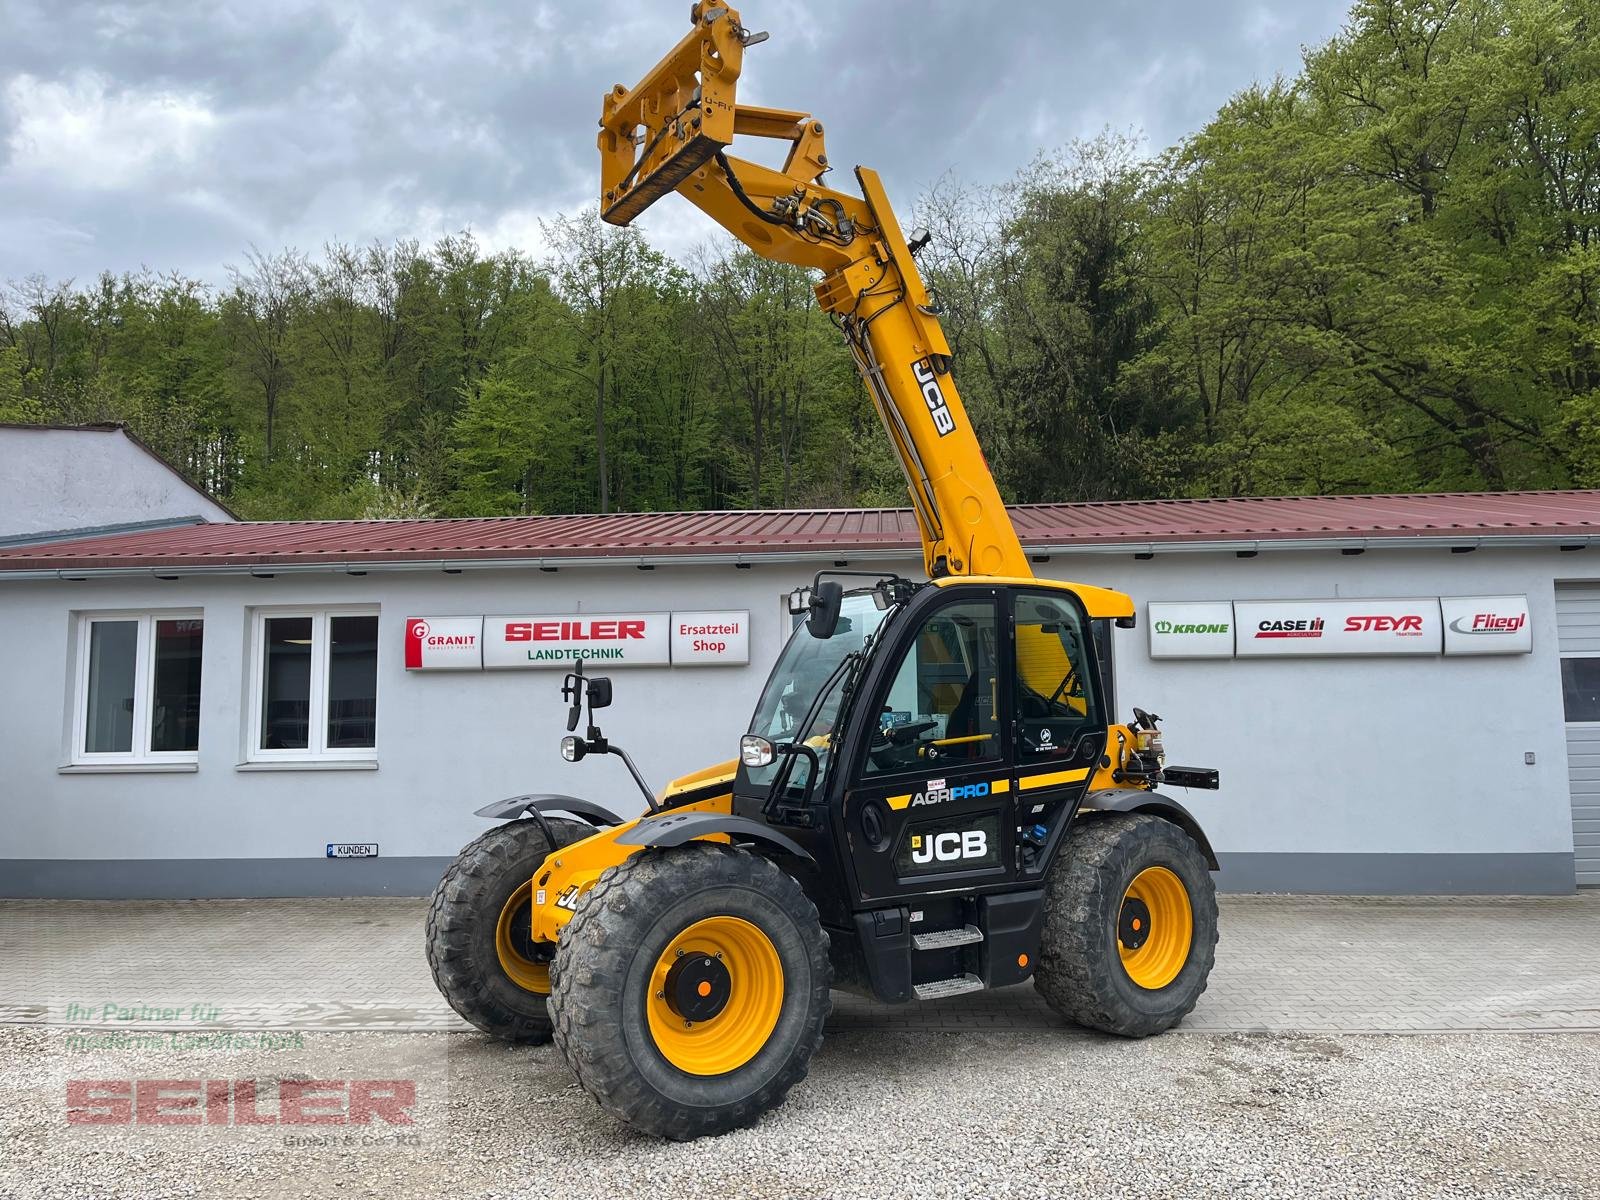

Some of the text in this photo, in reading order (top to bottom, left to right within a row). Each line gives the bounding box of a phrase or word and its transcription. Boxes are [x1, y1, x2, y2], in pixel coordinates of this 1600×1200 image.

[913, 362, 954, 435] JCB
[680, 622, 739, 636] Ersatzteil
[1172, 623, 1229, 634] KRONE
[1258, 620, 1307, 631] CASE
[1344, 616, 1423, 631] STEYR
[1472, 613, 1525, 631] Fliegl
[505, 620, 646, 641] SEILER
[427, 636, 476, 645] GRANIT
[693, 639, 726, 654] Shop
[528, 648, 624, 660] LANDTECHNIK
[337, 846, 371, 854] KUNDEN
[912, 830, 988, 864] JCB
